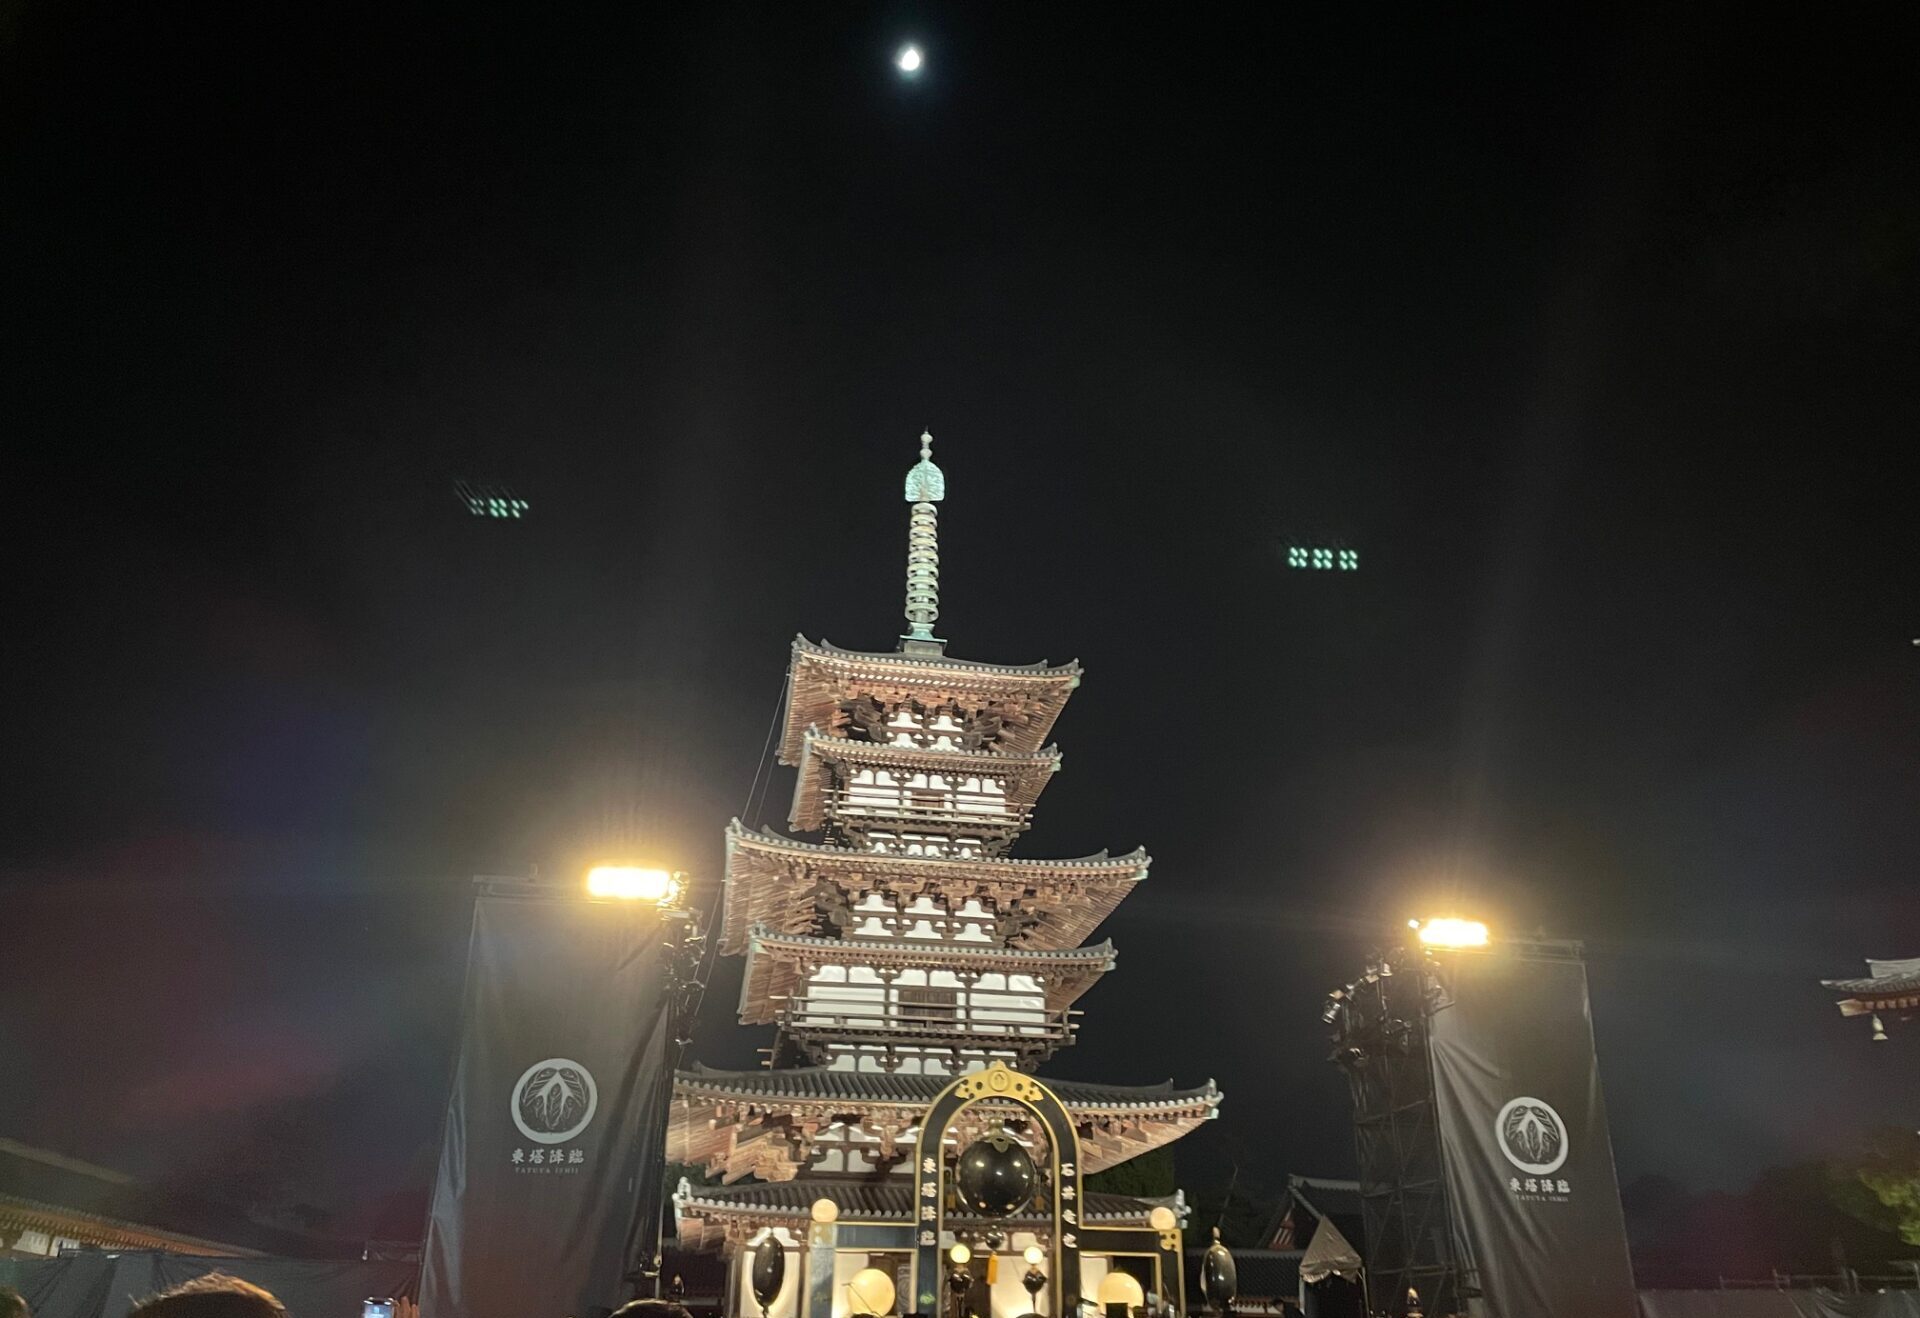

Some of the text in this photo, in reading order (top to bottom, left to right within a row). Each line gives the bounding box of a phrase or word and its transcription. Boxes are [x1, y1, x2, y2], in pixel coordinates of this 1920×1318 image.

[511, 1148, 584, 1164] 東塔降臨
[1509, 1177, 1571, 1193] 東塔降臨
